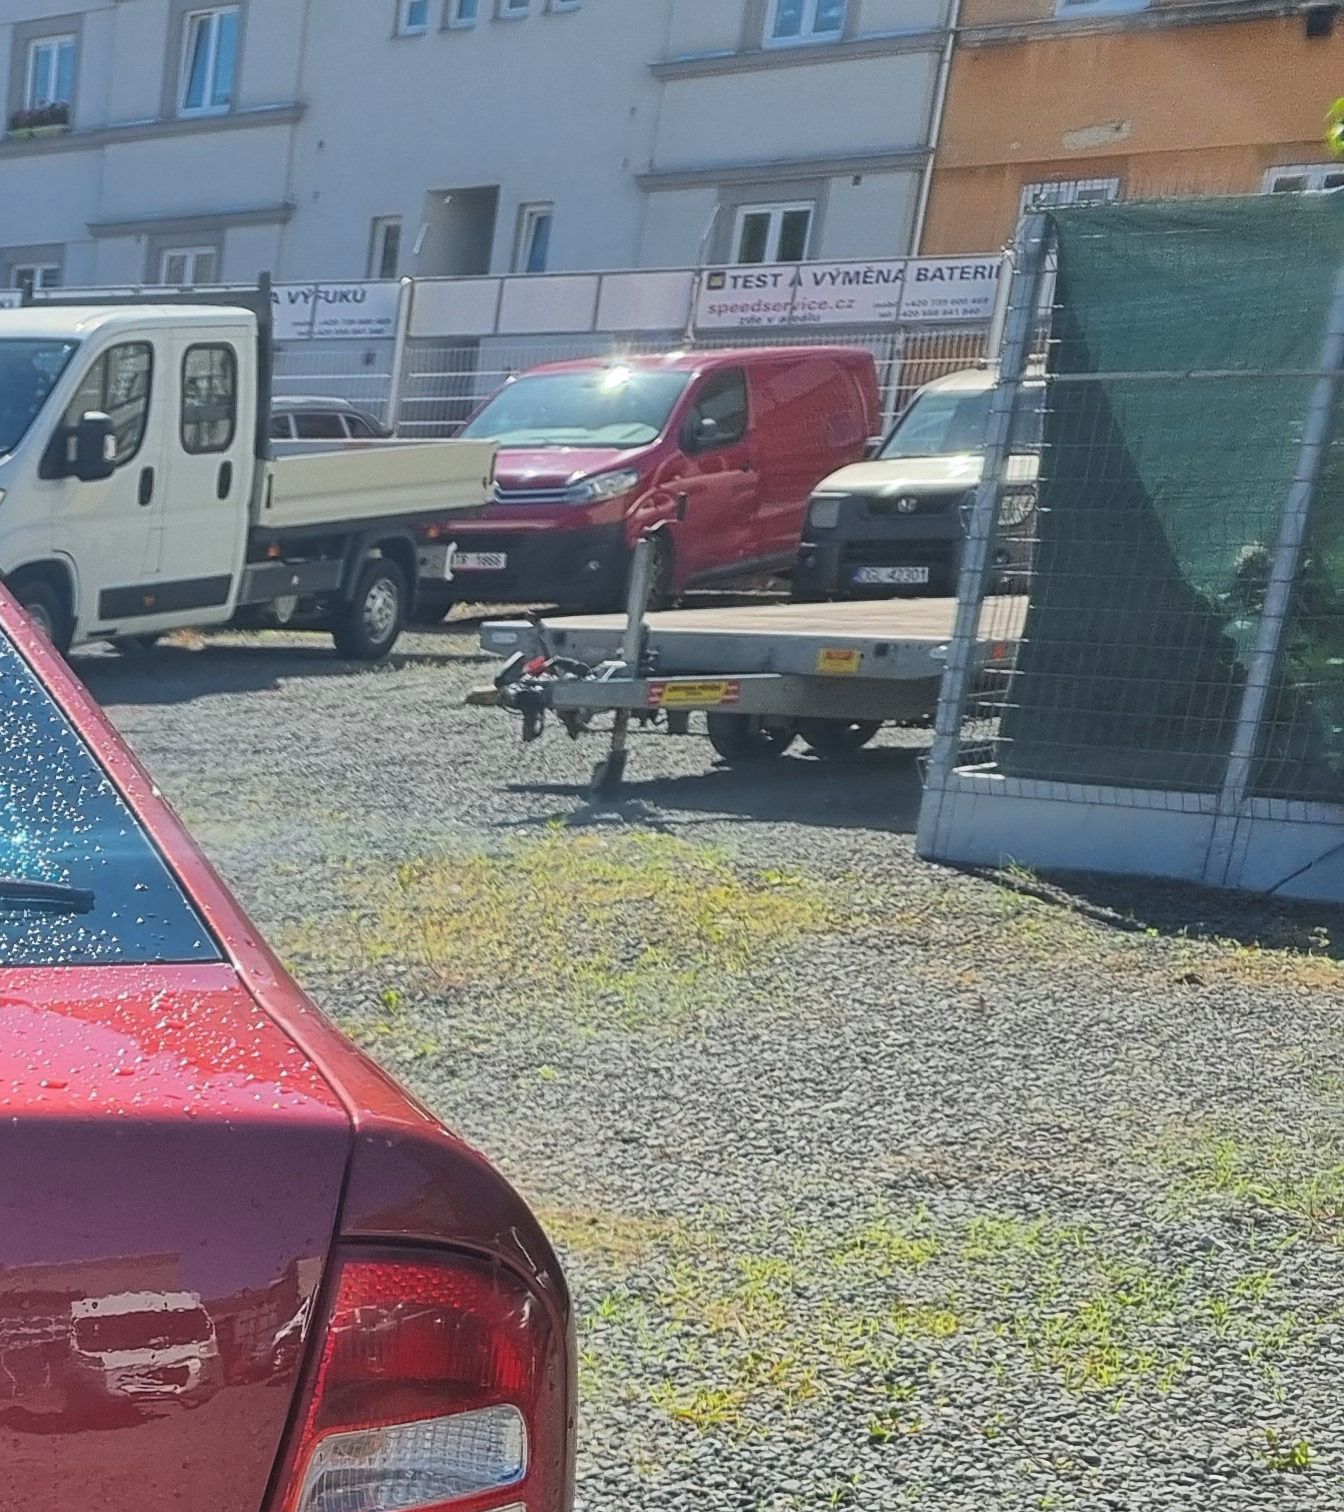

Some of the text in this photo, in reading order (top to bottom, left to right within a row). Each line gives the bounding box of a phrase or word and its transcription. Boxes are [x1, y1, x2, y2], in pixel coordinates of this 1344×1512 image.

[729, 273, 783, 289] TEST
[813, 265, 907, 286] VÝMĚNA
[707, 297, 856, 316] speedservice.cz
